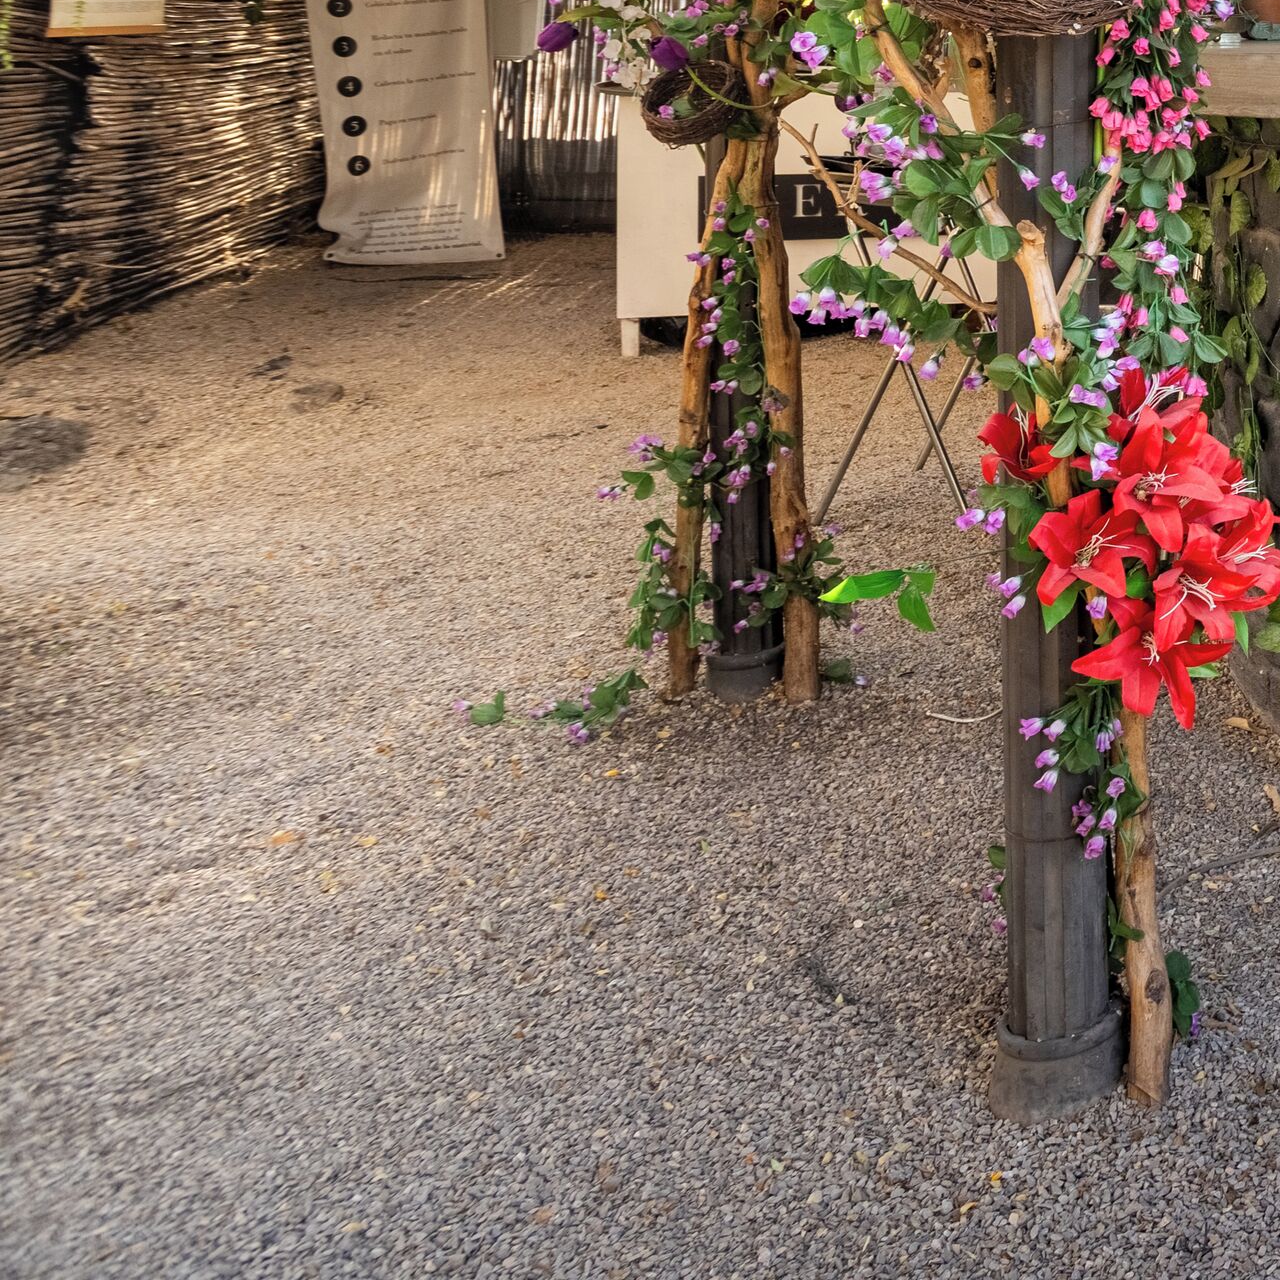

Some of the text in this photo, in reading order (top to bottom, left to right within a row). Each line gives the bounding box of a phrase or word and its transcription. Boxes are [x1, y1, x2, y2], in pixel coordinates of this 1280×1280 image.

[335, 1, 345, 12] 2
[341, 41, 349, 53] 3
[344, 81, 355, 92] 4
[351, 121, 360, 130] 5
[354, 160, 364, 172] 6
